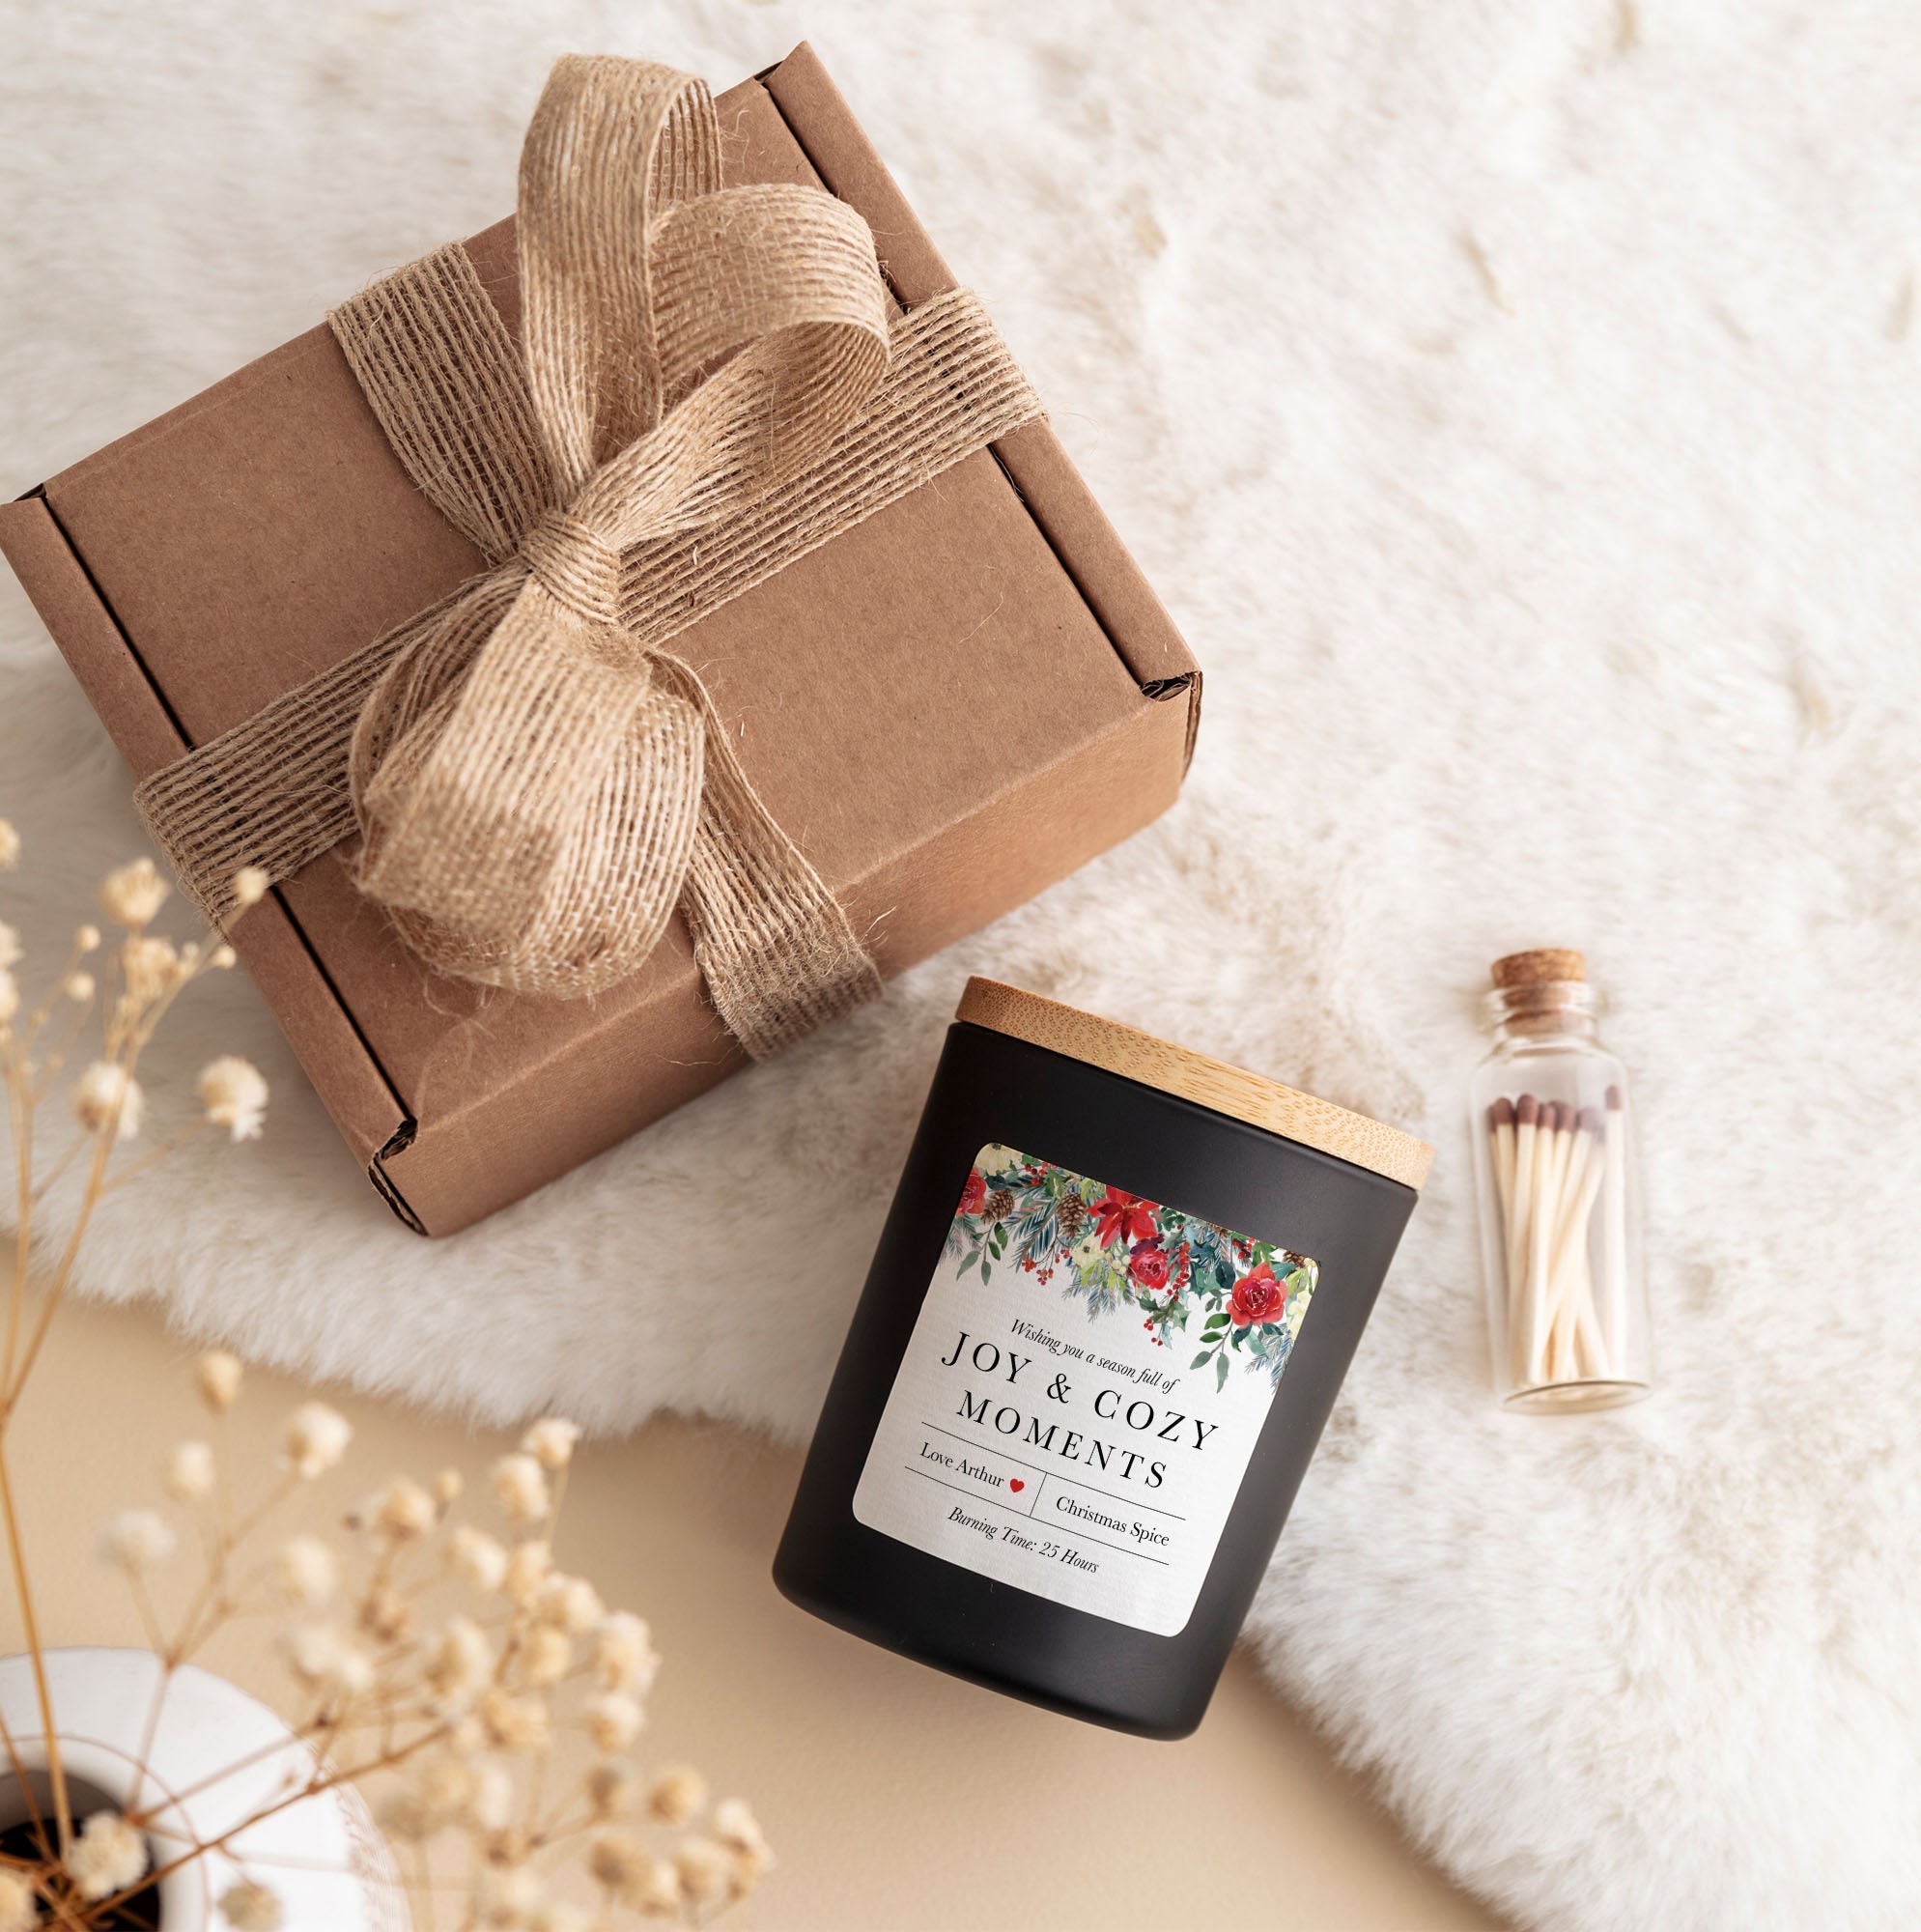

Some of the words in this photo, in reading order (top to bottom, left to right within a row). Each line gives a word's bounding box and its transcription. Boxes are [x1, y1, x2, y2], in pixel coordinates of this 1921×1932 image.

[941, 1331, 1031, 1383] JOY
[1046, 1373, 1072, 1404] &
[1094, 1389, 1219, 1451] COZY
[1011, 1320, 1062, 1356] Wishing
[1060, 1344, 1084, 1359] you
[1087, 1352, 1095, 1363] a
[1097, 1356, 1136, 1378] season
[1133, 1368, 1163, 1386] full
[1162, 1378, 1180, 1394] of
[919, 1442, 953, 1468] Love
[955, 1459, 1004, 1488] Arthur
[956, 1389, 1167, 1489] MOMENTS
[947, 1506, 999, 1540] Burning
[1001, 1526, 1036, 1551] Time:
[1038, 1544, 1059, 1558] 25
[1059, 1548, 1100, 1574] Hours
[1056, 1496, 1126, 1533] Christmas
[1130, 1521, 1170, 1547] Spice
